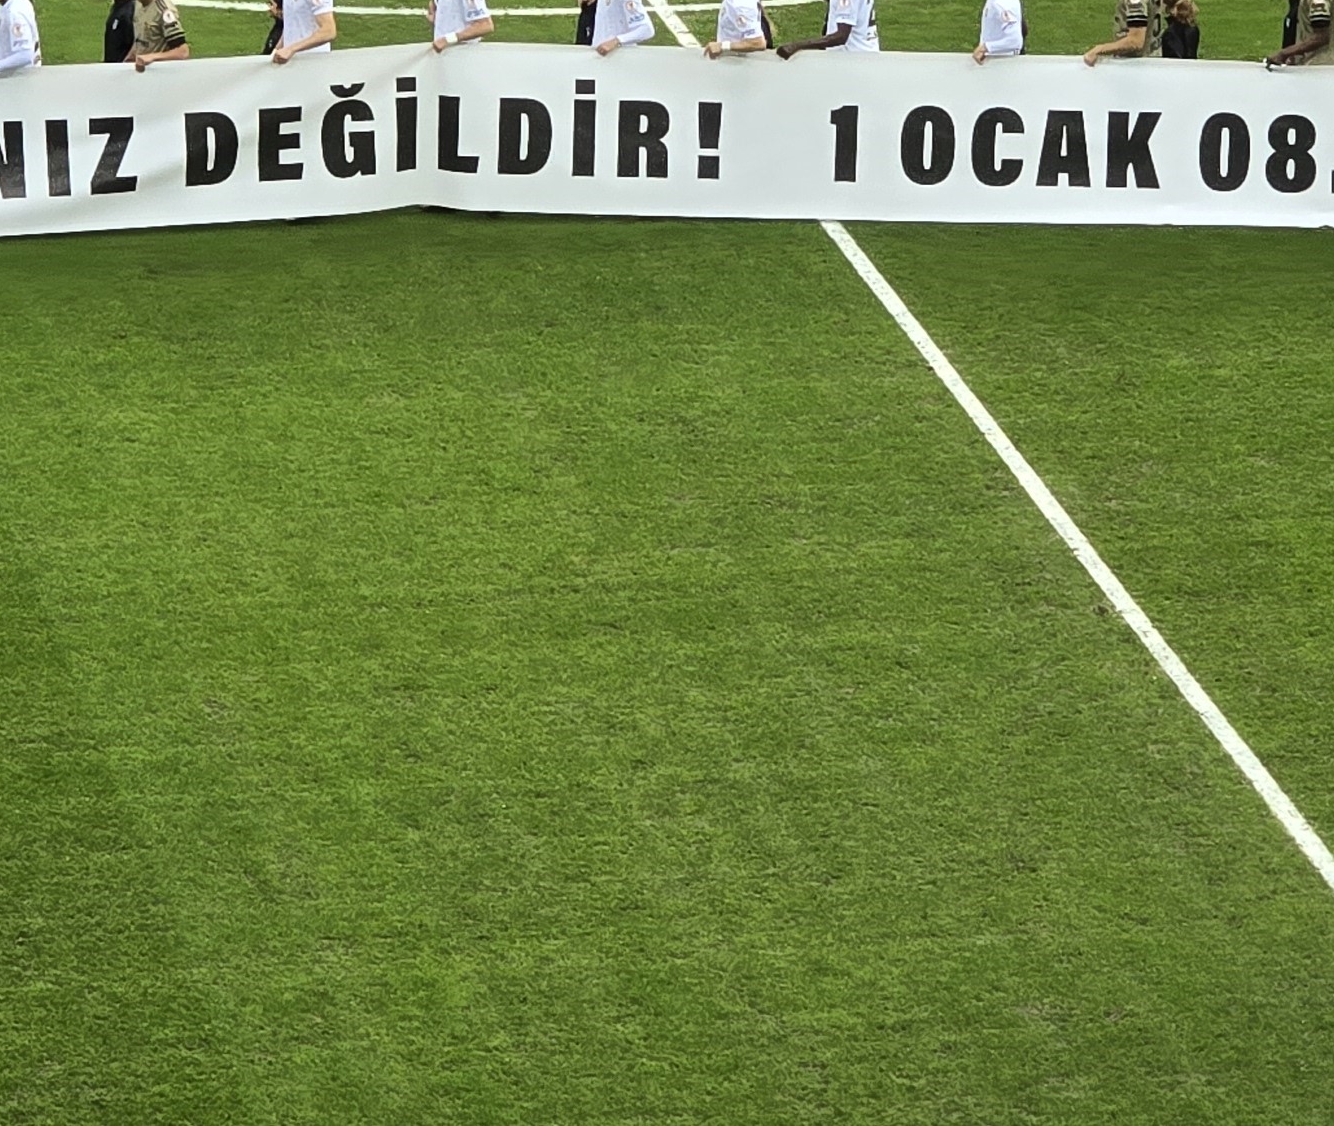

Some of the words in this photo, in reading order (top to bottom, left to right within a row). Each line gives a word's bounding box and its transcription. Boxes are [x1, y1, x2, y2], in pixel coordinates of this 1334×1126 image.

[184, 76, 723, 187] DEĞİLDİR!
[830, 105, 859, 183] 1
[900, 105, 1162, 189] OCAK
